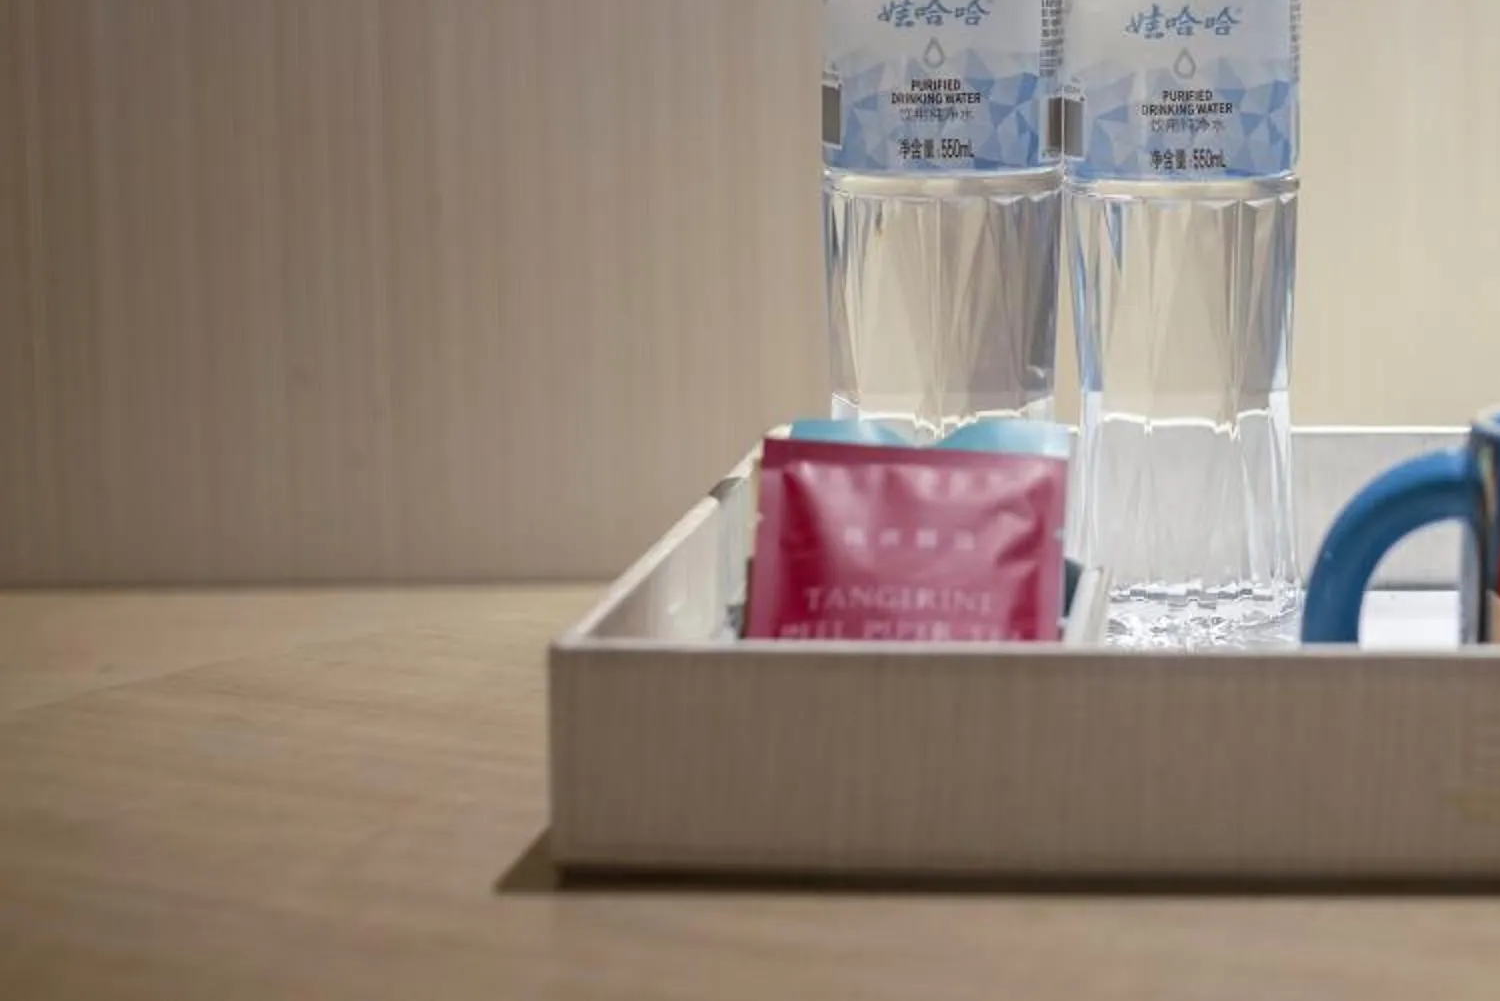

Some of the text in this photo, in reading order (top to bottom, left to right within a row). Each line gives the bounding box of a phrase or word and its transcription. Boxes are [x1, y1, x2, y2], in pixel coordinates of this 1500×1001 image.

[1124, 3, 1241, 39] 娃哈哈
[911, 78, 961, 91] PURIFIED
[891, 92, 981, 105] DRINKING WATER
[1161, 90, 1213, 103] PURIFIED
[1141, 102, 1233, 116] DRINKING WATER
